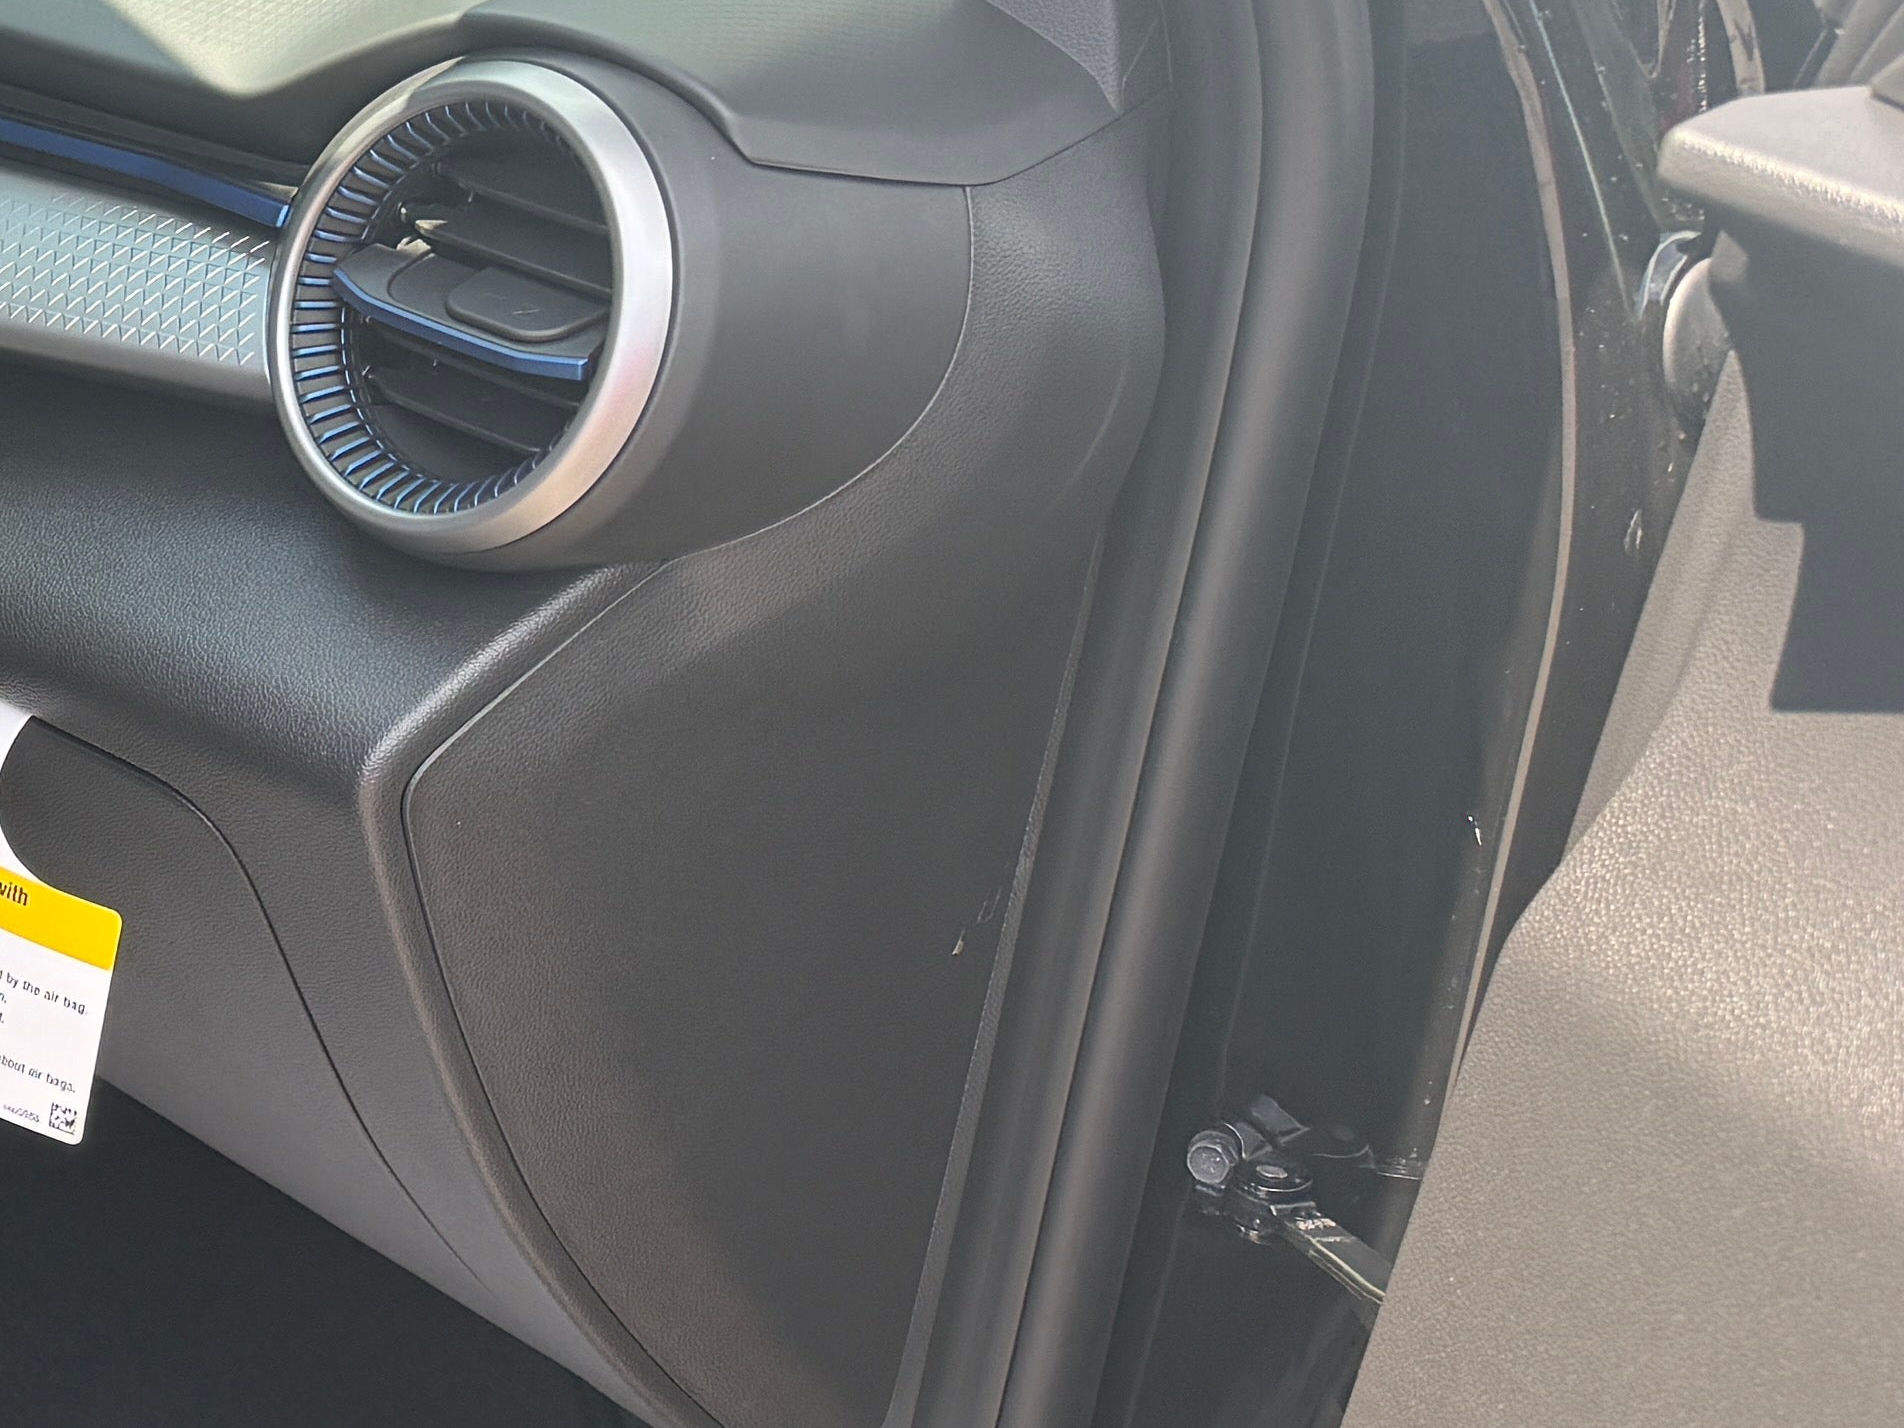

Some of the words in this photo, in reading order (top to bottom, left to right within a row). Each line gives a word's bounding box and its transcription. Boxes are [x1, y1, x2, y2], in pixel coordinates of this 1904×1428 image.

[6, 971, 19, 989] by
[22, 980, 41, 996] the
[43, 989, 59, 1003] air
